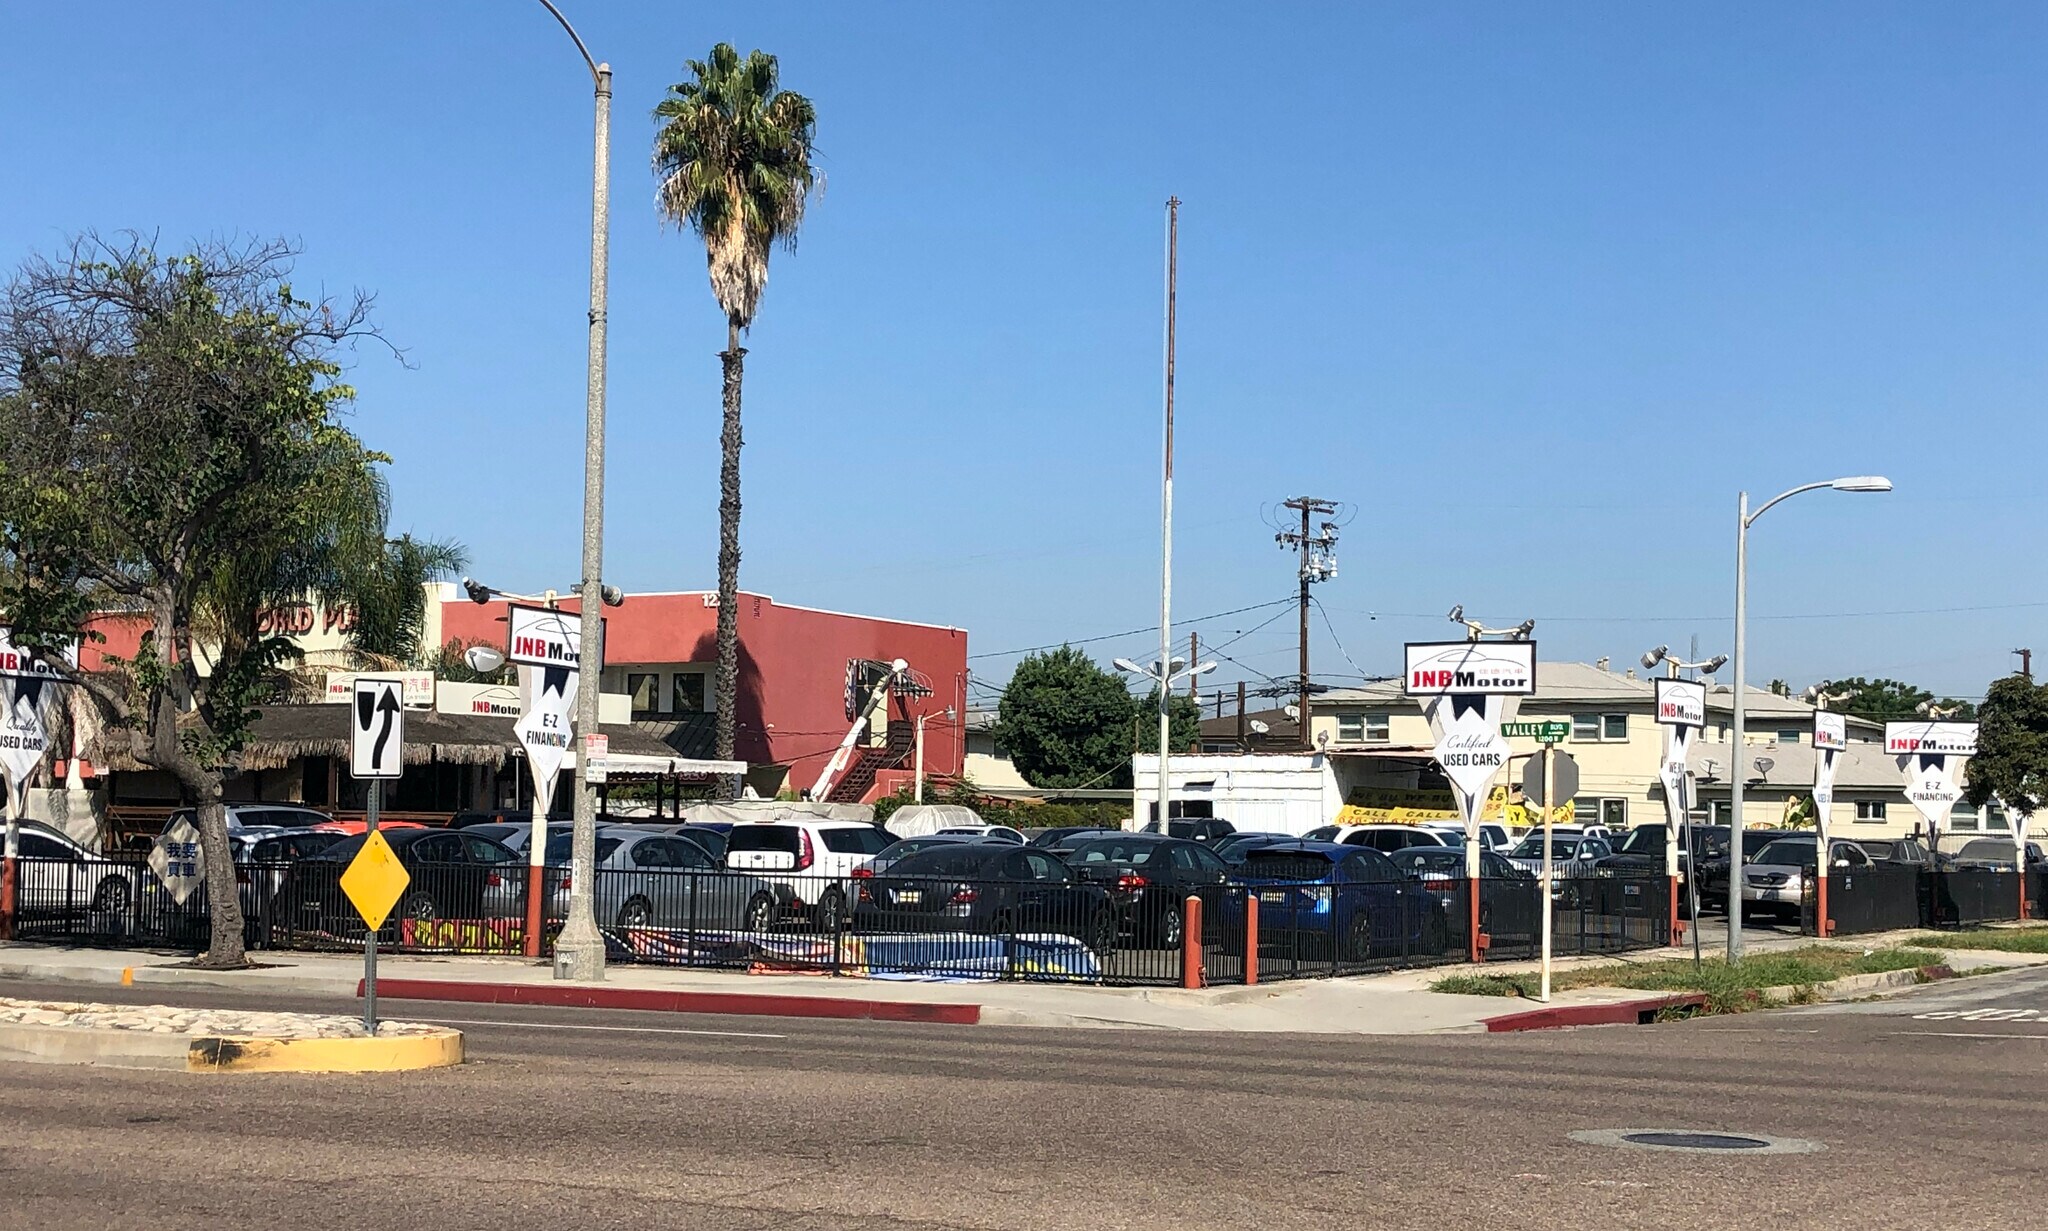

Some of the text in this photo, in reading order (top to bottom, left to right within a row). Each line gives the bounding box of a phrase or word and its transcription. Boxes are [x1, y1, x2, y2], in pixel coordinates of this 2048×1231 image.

[255, 604, 315, 635] ORLD
[543, 713, 558, 728] E-Z
[1505, 724, 1543, 736] VALLEY
[22, 736, 42, 751] CARS
[526, 730, 566, 748] FINANCING
[1447, 733, 1495, 751] Certified
[1443, 753, 1501, 767] USED CARS
[1925, 781, 1941, 790] E-Z
[1912, 792, 1954, 802] FINANCING
[1353, 809, 1388, 818] CALL
[167, 842, 196, 858] 我要
[167, 862, 196, 878] 買車
